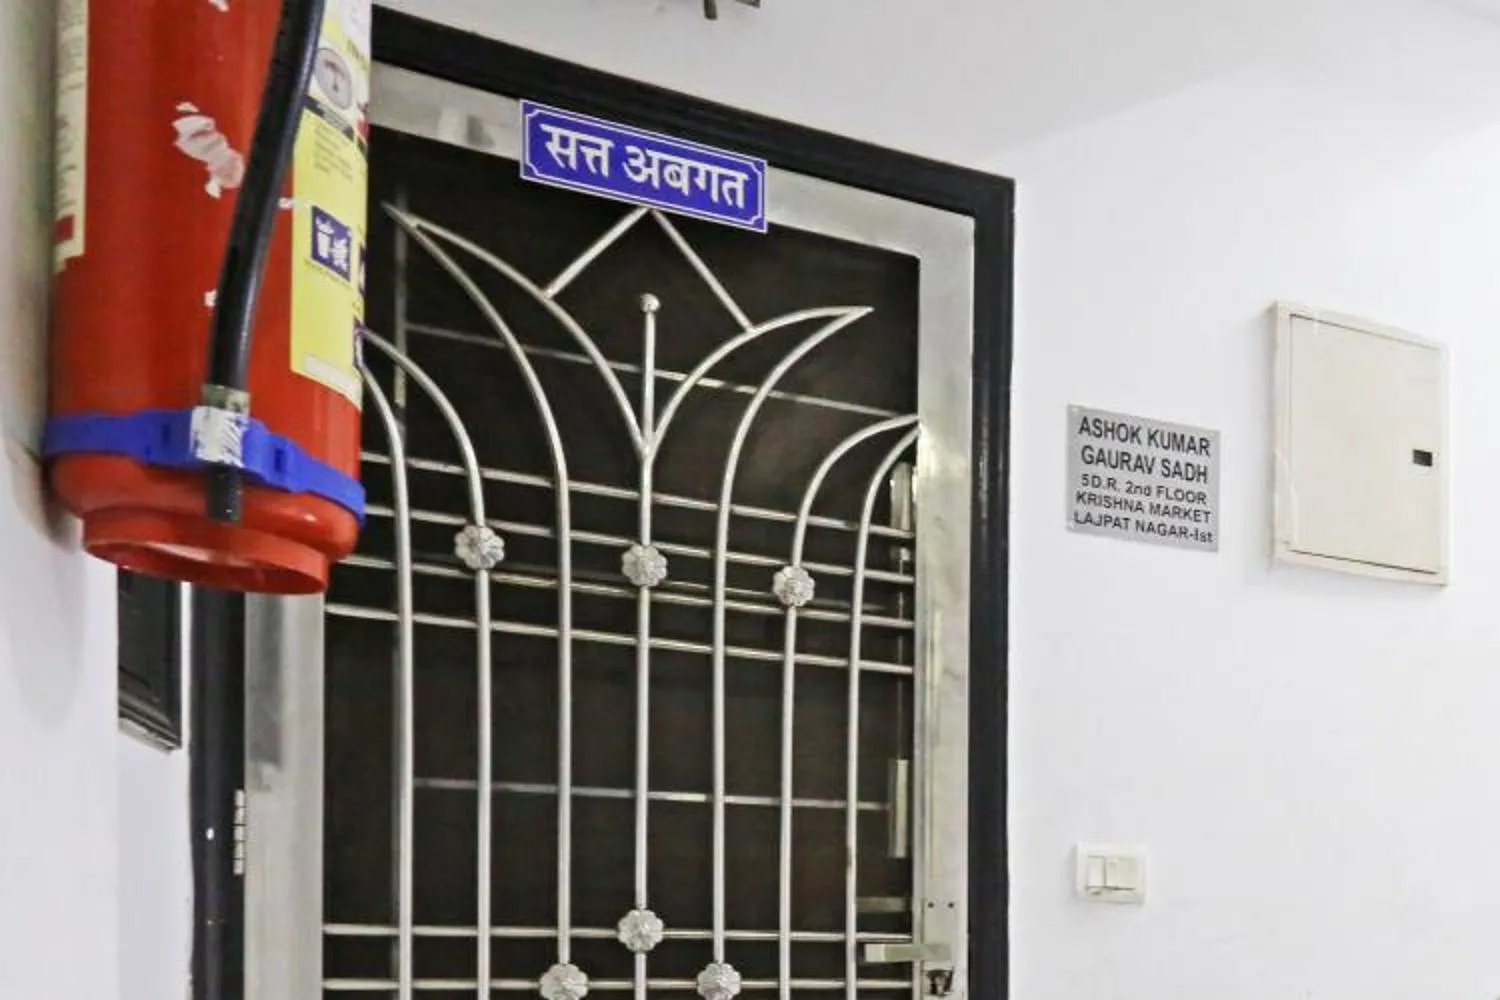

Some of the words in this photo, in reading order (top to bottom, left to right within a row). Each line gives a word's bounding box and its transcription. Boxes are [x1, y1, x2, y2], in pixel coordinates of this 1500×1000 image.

[621, 145, 749, 209] अबगत
[1078, 416, 1143, 446] ASHOK
[1147, 428, 1210, 458] KUMAR
[1081, 445, 1156, 475] GAURAV
[1161, 458, 1208, 484] SADH
[1075, 491, 1145, 514] KRISHNA
[1149, 502, 1212, 524] MARKET
[1125, 480, 1152, 497] 2nd
[1156, 485, 1207, 505] FLOOR
[1073, 511, 1131, 532] LAJPAT
